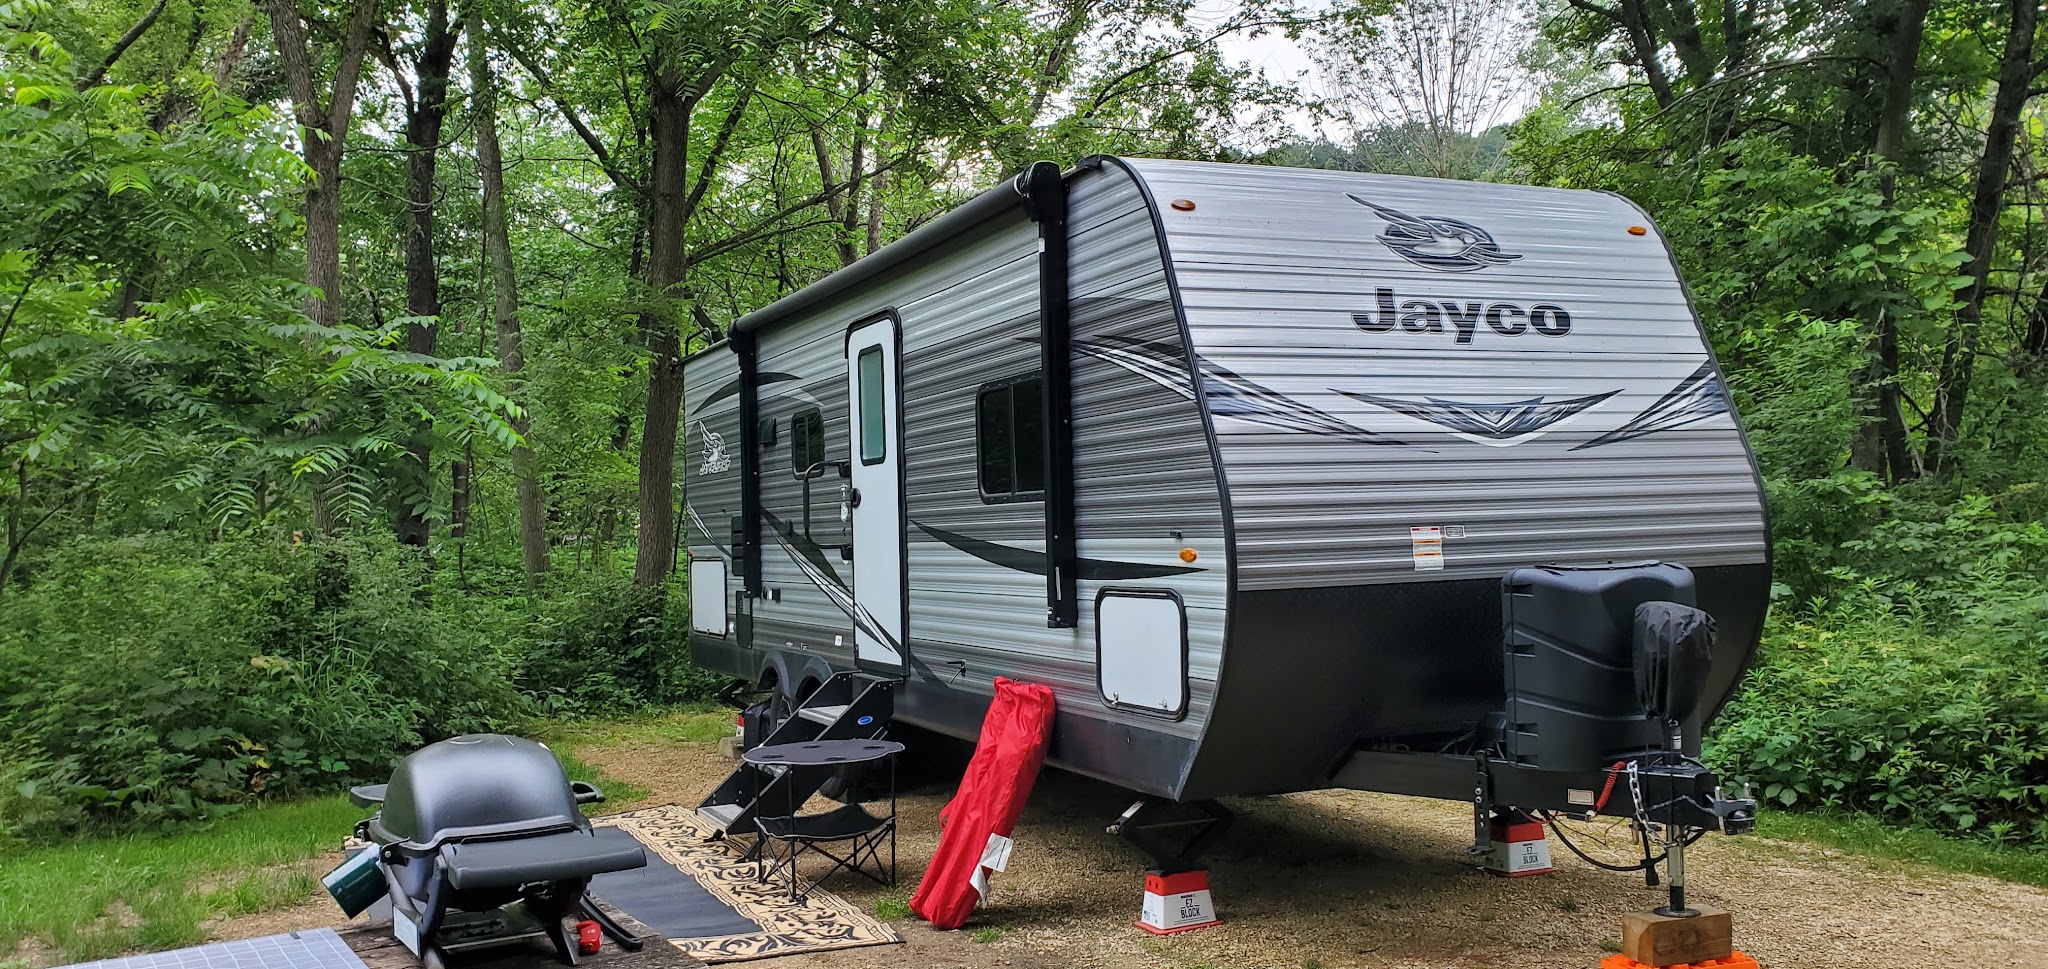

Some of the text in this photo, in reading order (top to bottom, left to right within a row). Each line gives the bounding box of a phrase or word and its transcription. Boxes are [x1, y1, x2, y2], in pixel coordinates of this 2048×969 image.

[1350, 286, 1573, 345] Jayco
[1523, 855, 1538, 864] BLOCK
[1186, 898, 1193, 908] EZ
[1181, 907, 1200, 918] BLOCK
